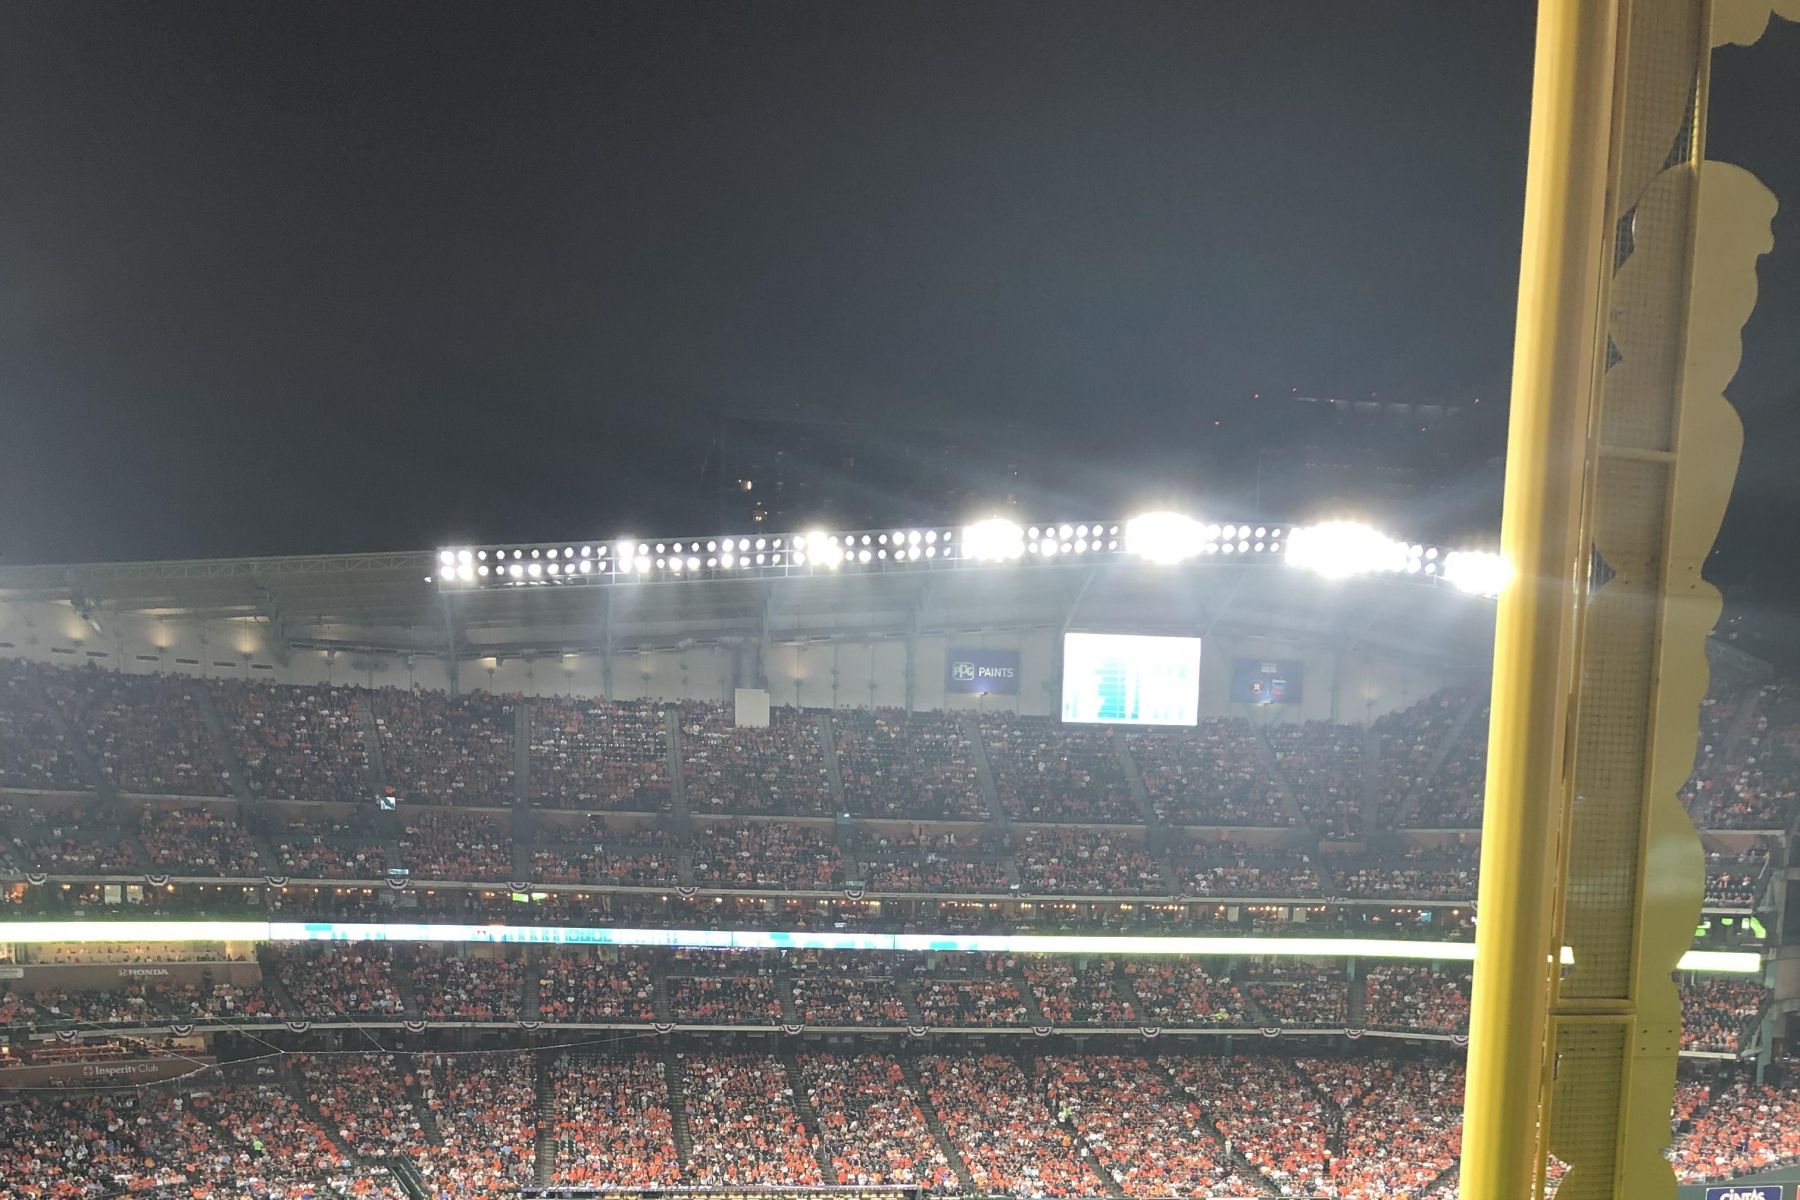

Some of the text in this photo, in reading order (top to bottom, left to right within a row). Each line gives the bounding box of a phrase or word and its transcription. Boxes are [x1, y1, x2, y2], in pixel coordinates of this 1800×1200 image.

[954, 664, 1014, 679] PPG PAINTS
[128, 968, 169, 976] HONDA
[95, 1064, 159, 1077] Insperity Club
